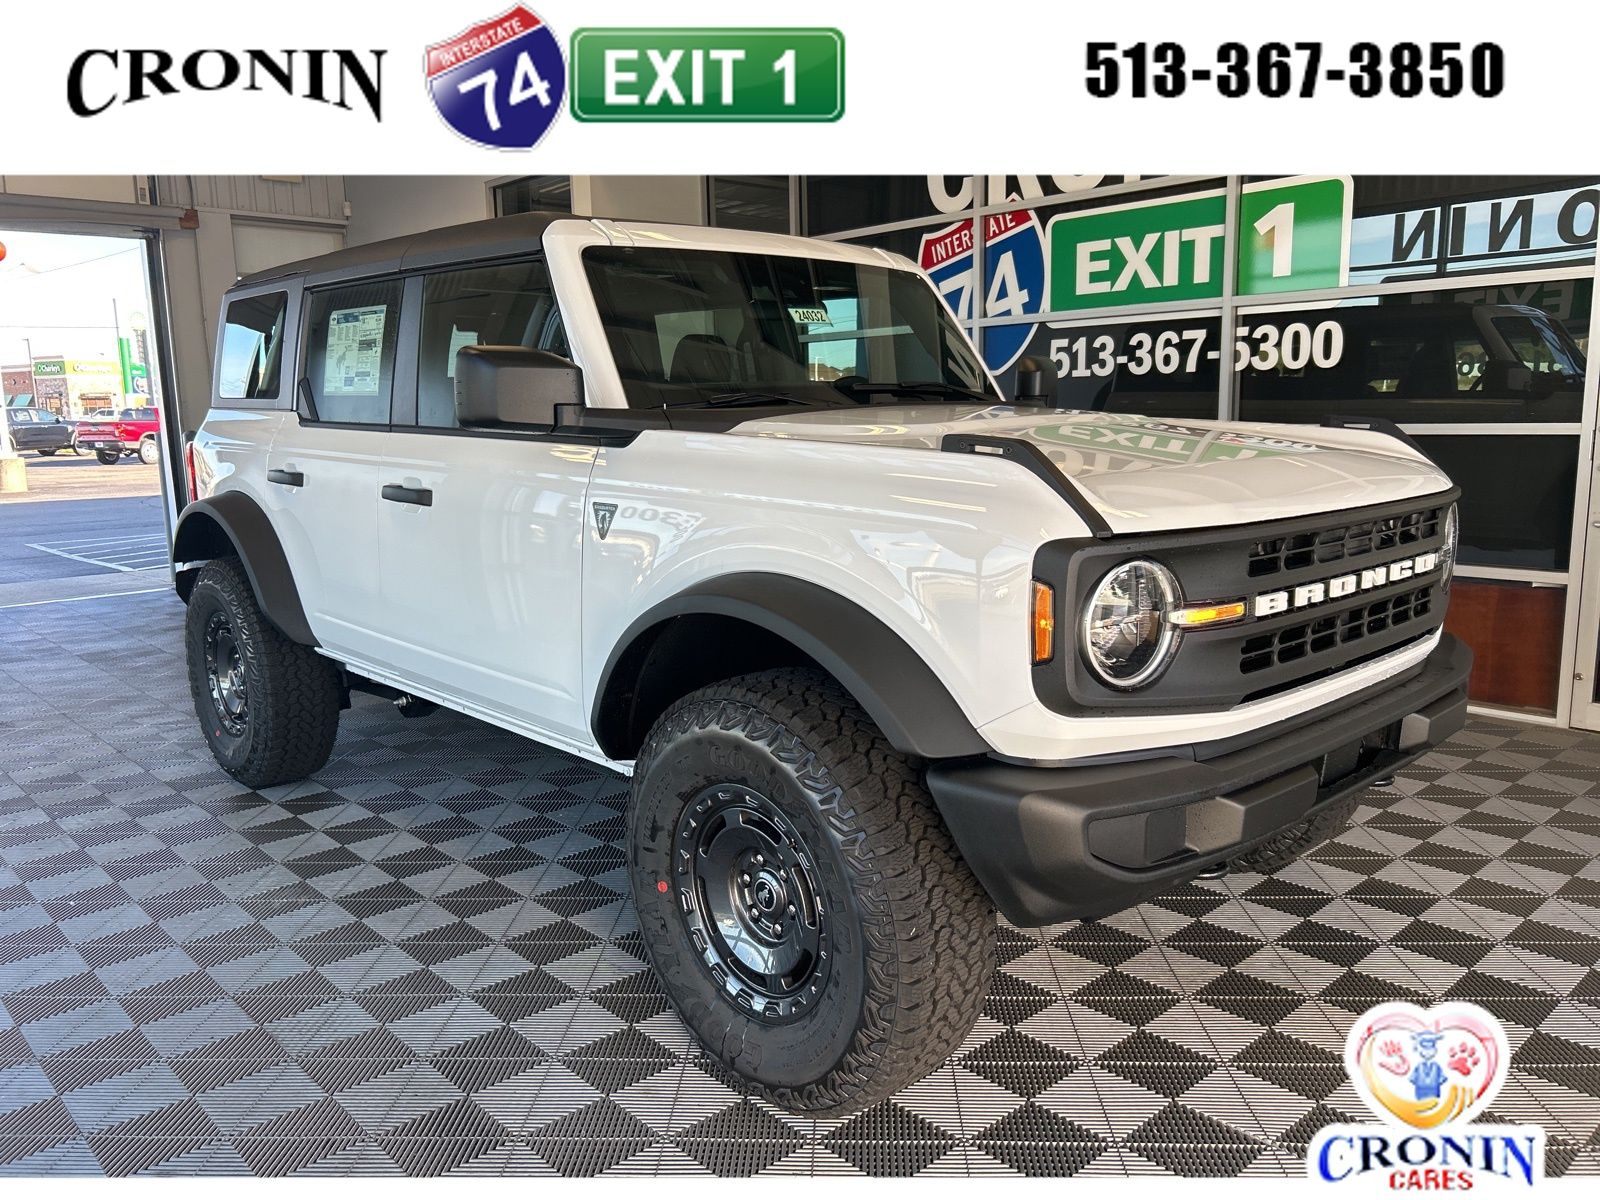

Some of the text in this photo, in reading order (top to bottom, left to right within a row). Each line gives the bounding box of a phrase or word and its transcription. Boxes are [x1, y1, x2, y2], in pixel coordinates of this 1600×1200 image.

[931, 212, 1016, 264] INTERSATE
[1075, 202, 1294, 295] EXIT 1
[795, 310, 827, 322] 24032
[938, 250, 1029, 341] 74
[1050, 320, 1344, 379] 513-367-5300
[1255, 552, 1438, 617] BRONCO
